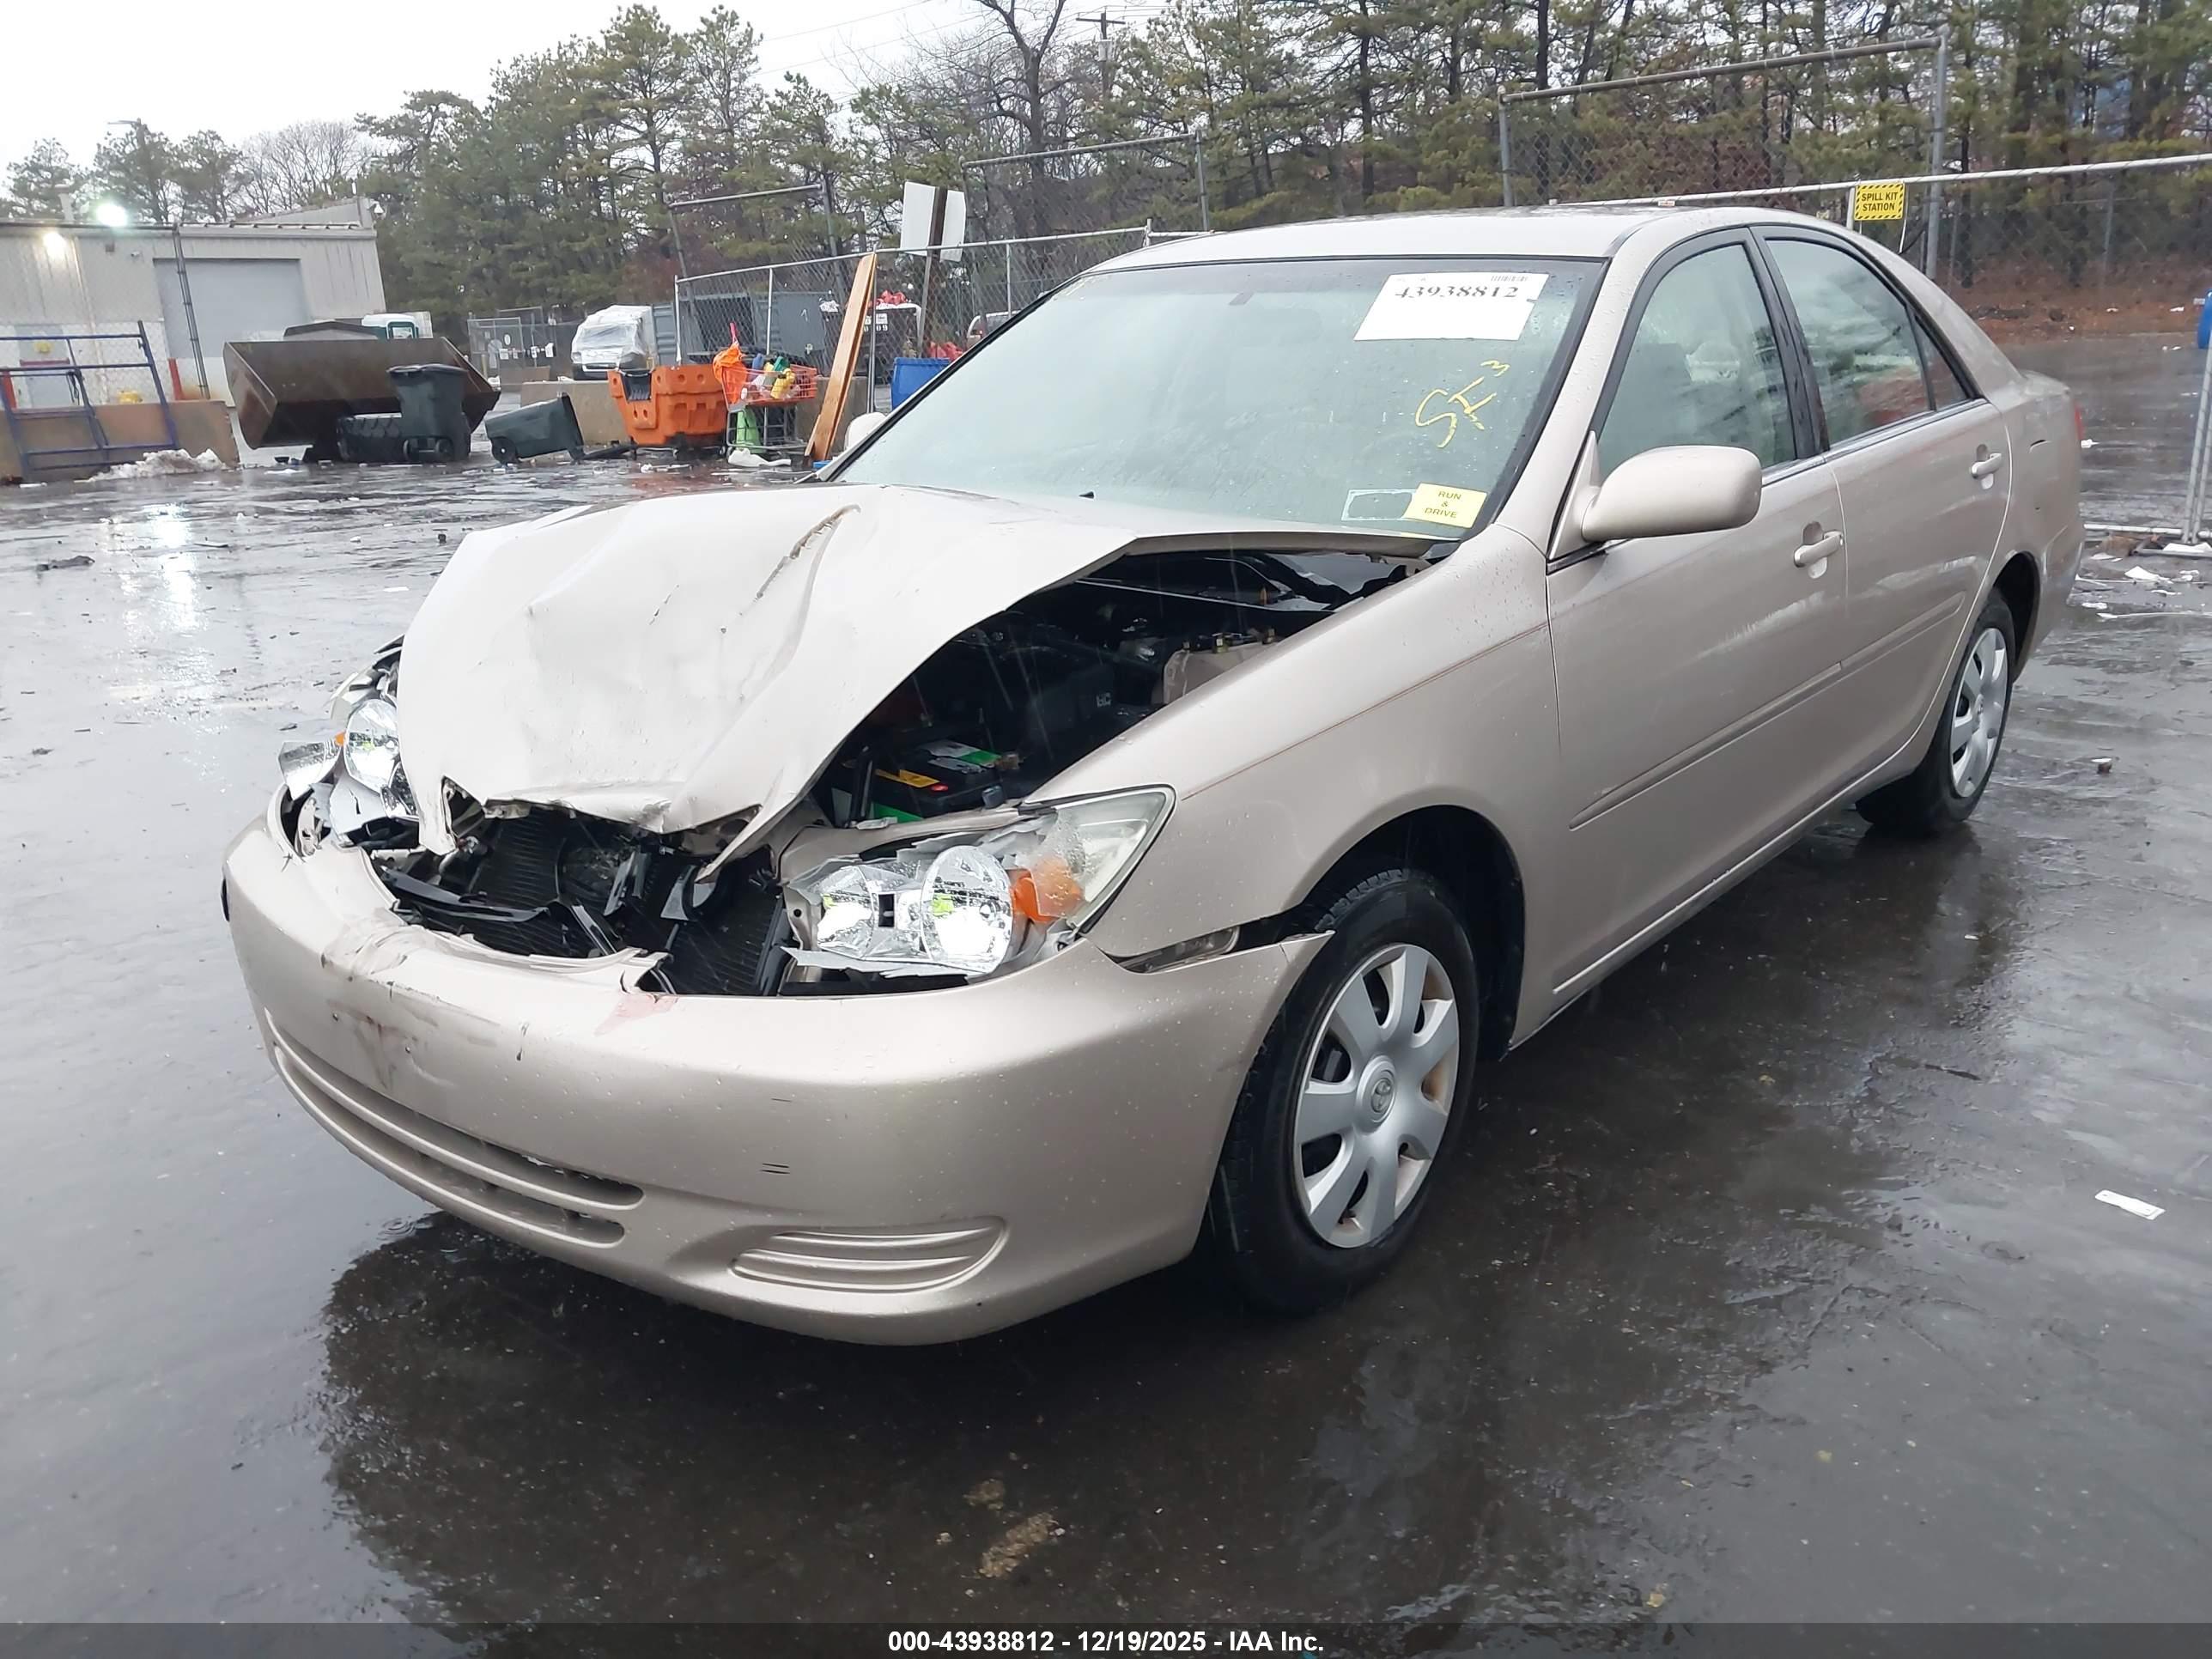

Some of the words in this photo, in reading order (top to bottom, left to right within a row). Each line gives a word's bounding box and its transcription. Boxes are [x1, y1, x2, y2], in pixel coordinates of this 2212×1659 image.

[1863, 203, 1895, 211] STATION
[1395, 285, 1519, 298] 43938812
[1438, 490, 1462, 500] RUN
[1425, 507, 1458, 519] DRIVE
